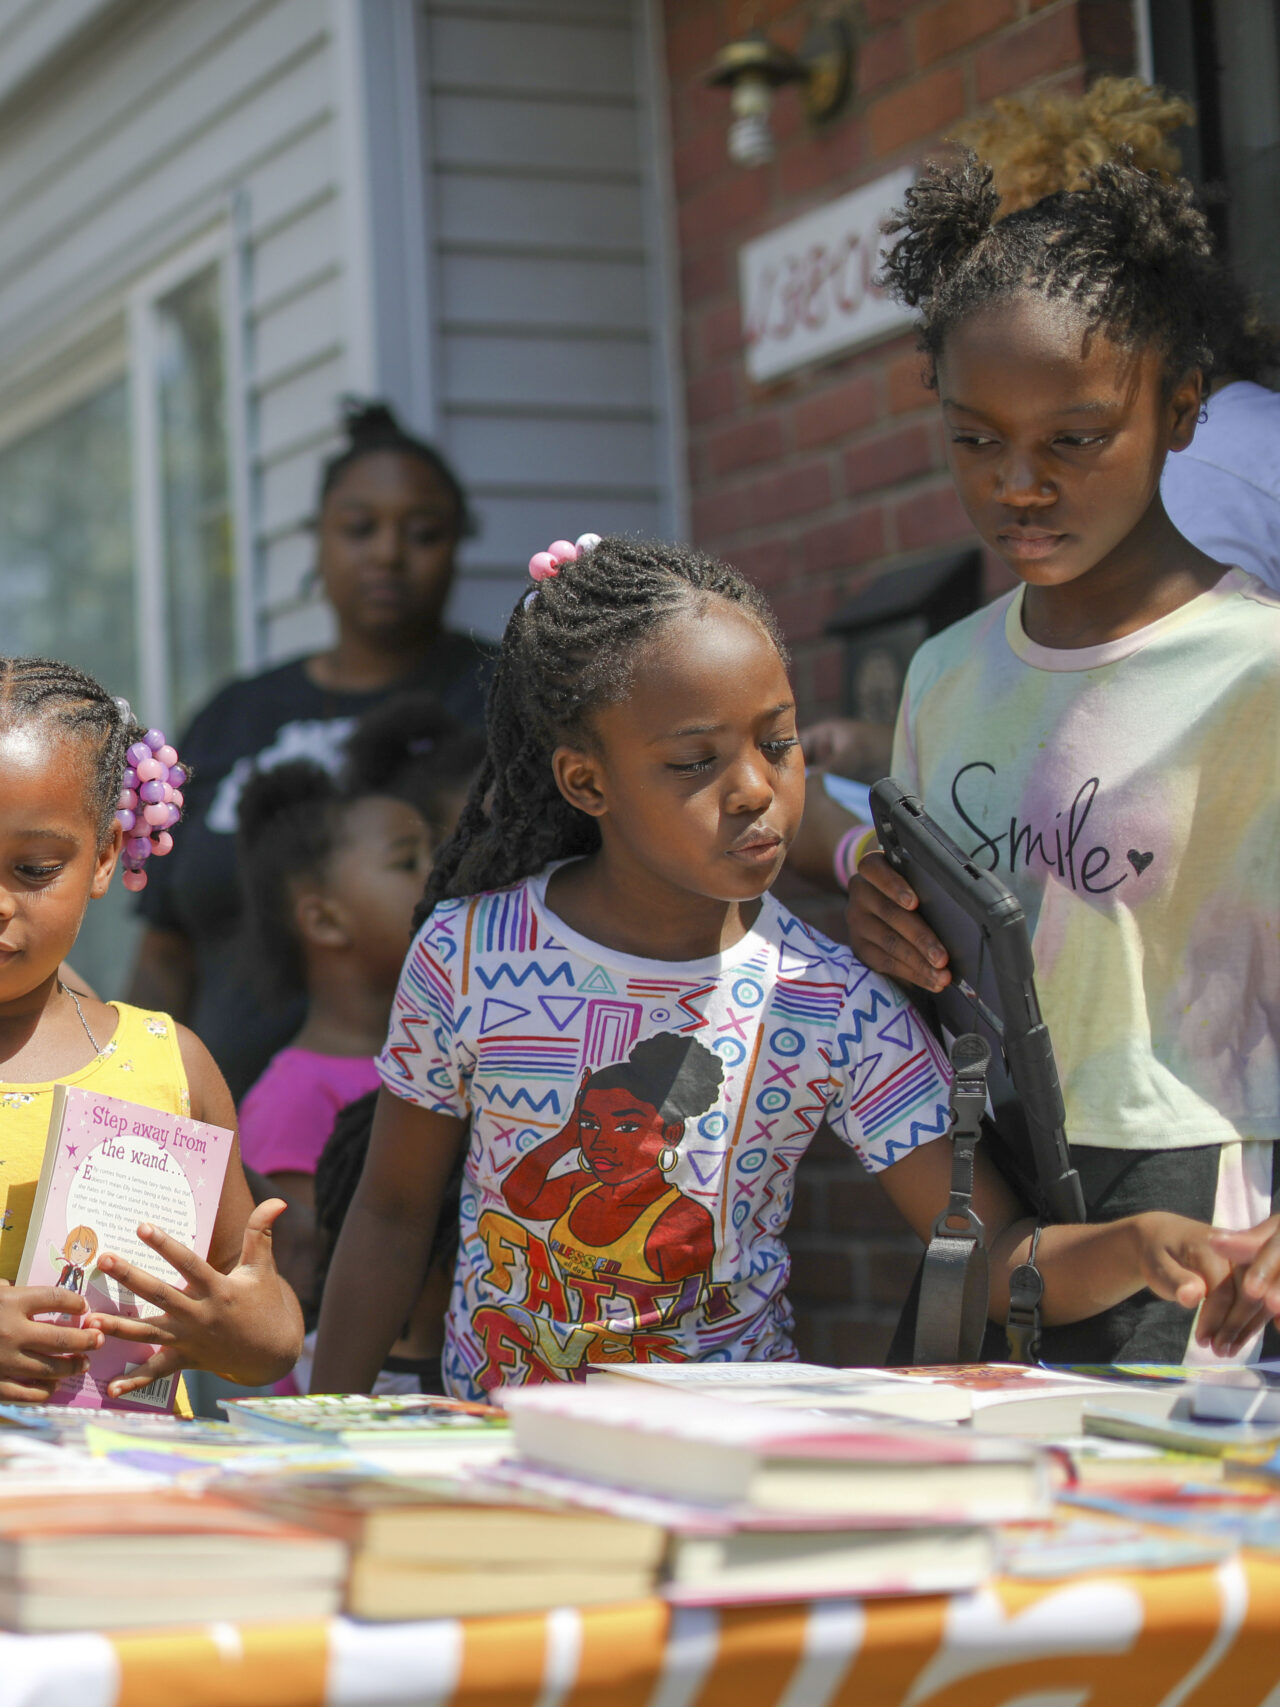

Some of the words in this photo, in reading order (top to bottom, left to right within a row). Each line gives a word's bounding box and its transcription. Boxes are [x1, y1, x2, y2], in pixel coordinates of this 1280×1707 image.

[951, 761, 1128, 894] Smile
[92, 1105, 128, 1137] Step
[132, 1121, 169, 1150] away
[172, 1127, 207, 1154] from
[101, 1136, 125, 1160] the
[478, 1208, 740, 1333] FAITH
